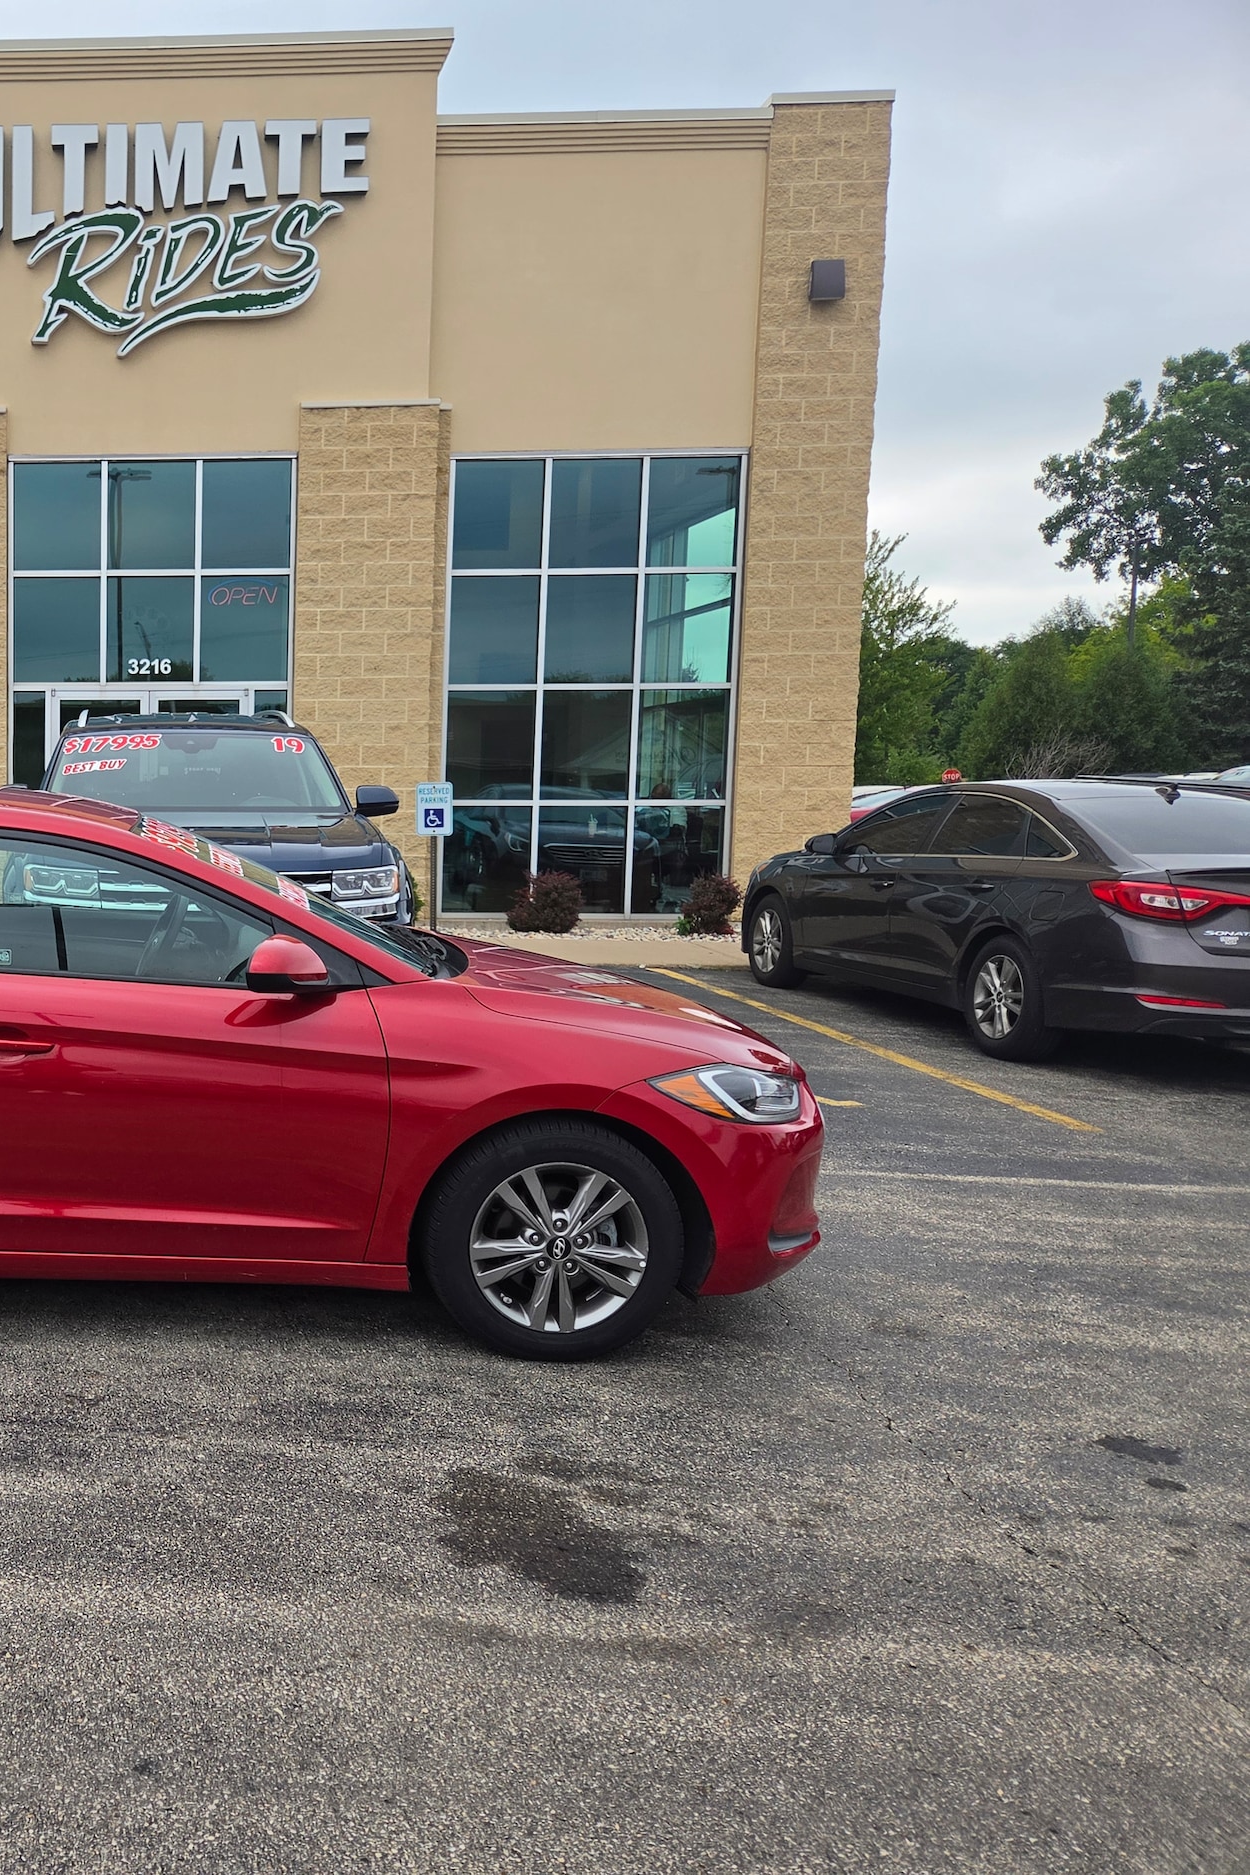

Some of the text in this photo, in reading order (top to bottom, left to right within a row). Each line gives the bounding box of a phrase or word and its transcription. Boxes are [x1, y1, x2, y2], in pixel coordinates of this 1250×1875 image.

[210, 586, 278, 606] OPEN
[128, 658, 172, 675] 3216
[63, 734, 162, 755] $17995
[270, 736, 305, 754] 19
[63, 759, 127, 775] BEST BUY
[943, 773, 960, 782] STOP
[418, 787, 450, 795] RESERVED
[421, 796, 448, 804] PARKING
